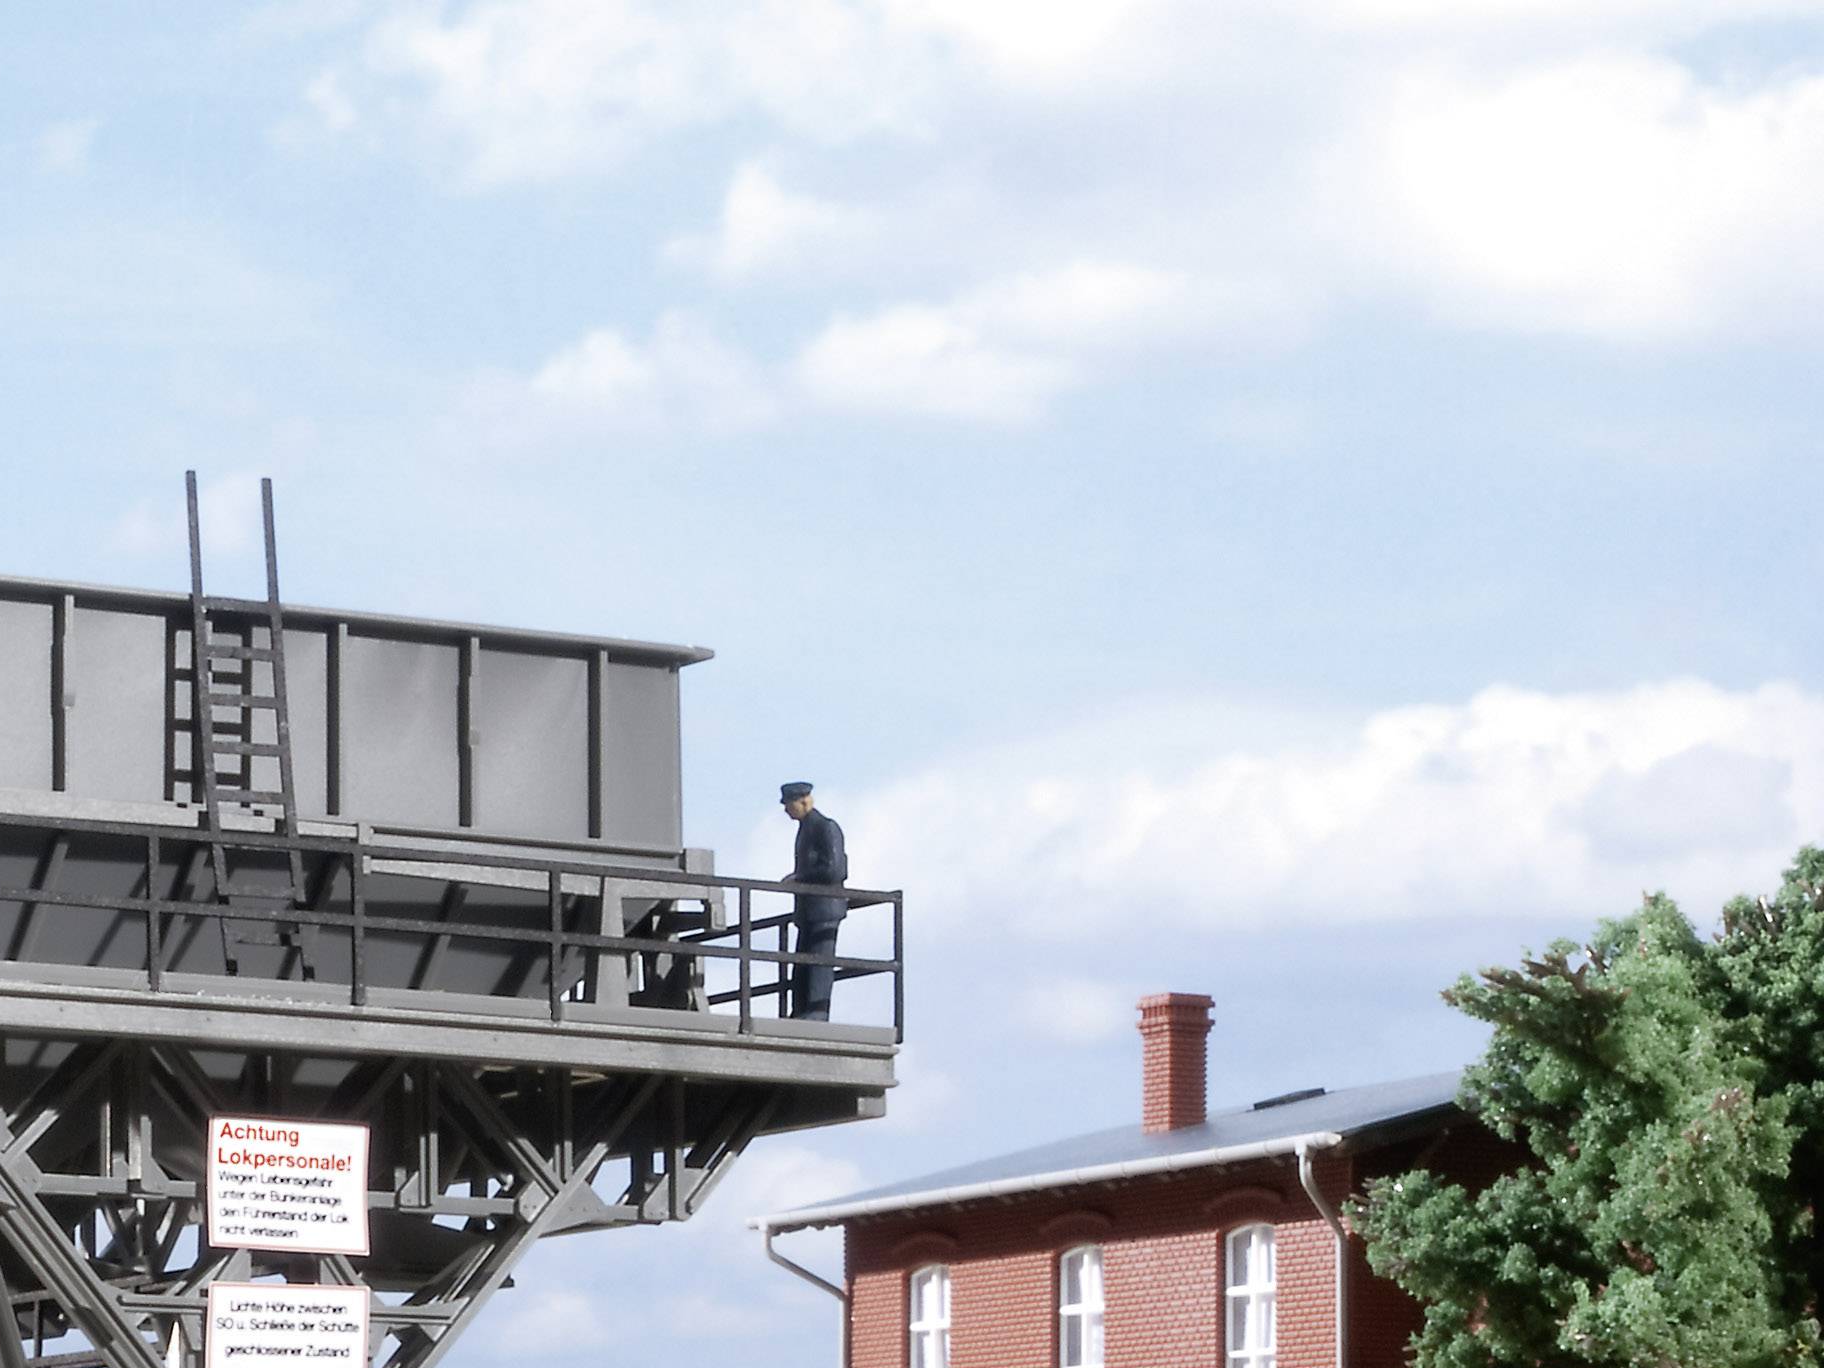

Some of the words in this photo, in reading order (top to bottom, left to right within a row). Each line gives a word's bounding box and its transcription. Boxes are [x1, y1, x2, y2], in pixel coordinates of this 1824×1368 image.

[220, 1122, 299, 1147] Achtung
[218, 1147, 352, 1171] Lokpersonale!
[218, 1170, 257, 1185] Wegen
[260, 1173, 333, 1189] Lebensgefahr
[218, 1190, 245, 1200] unter
[249, 1191, 266, 1200] der
[219, 1207, 240, 1217] den
[311, 1211, 327, 1222] der
[219, 1225, 245, 1235] nicht
[230, 1300, 263, 1312] Lichte
[266, 1301, 295, 1313] Höhe
[298, 1303, 348, 1315] zwischen
[298, 1320, 315, 1331] der
[305, 1345, 350, 1358] Zustand
